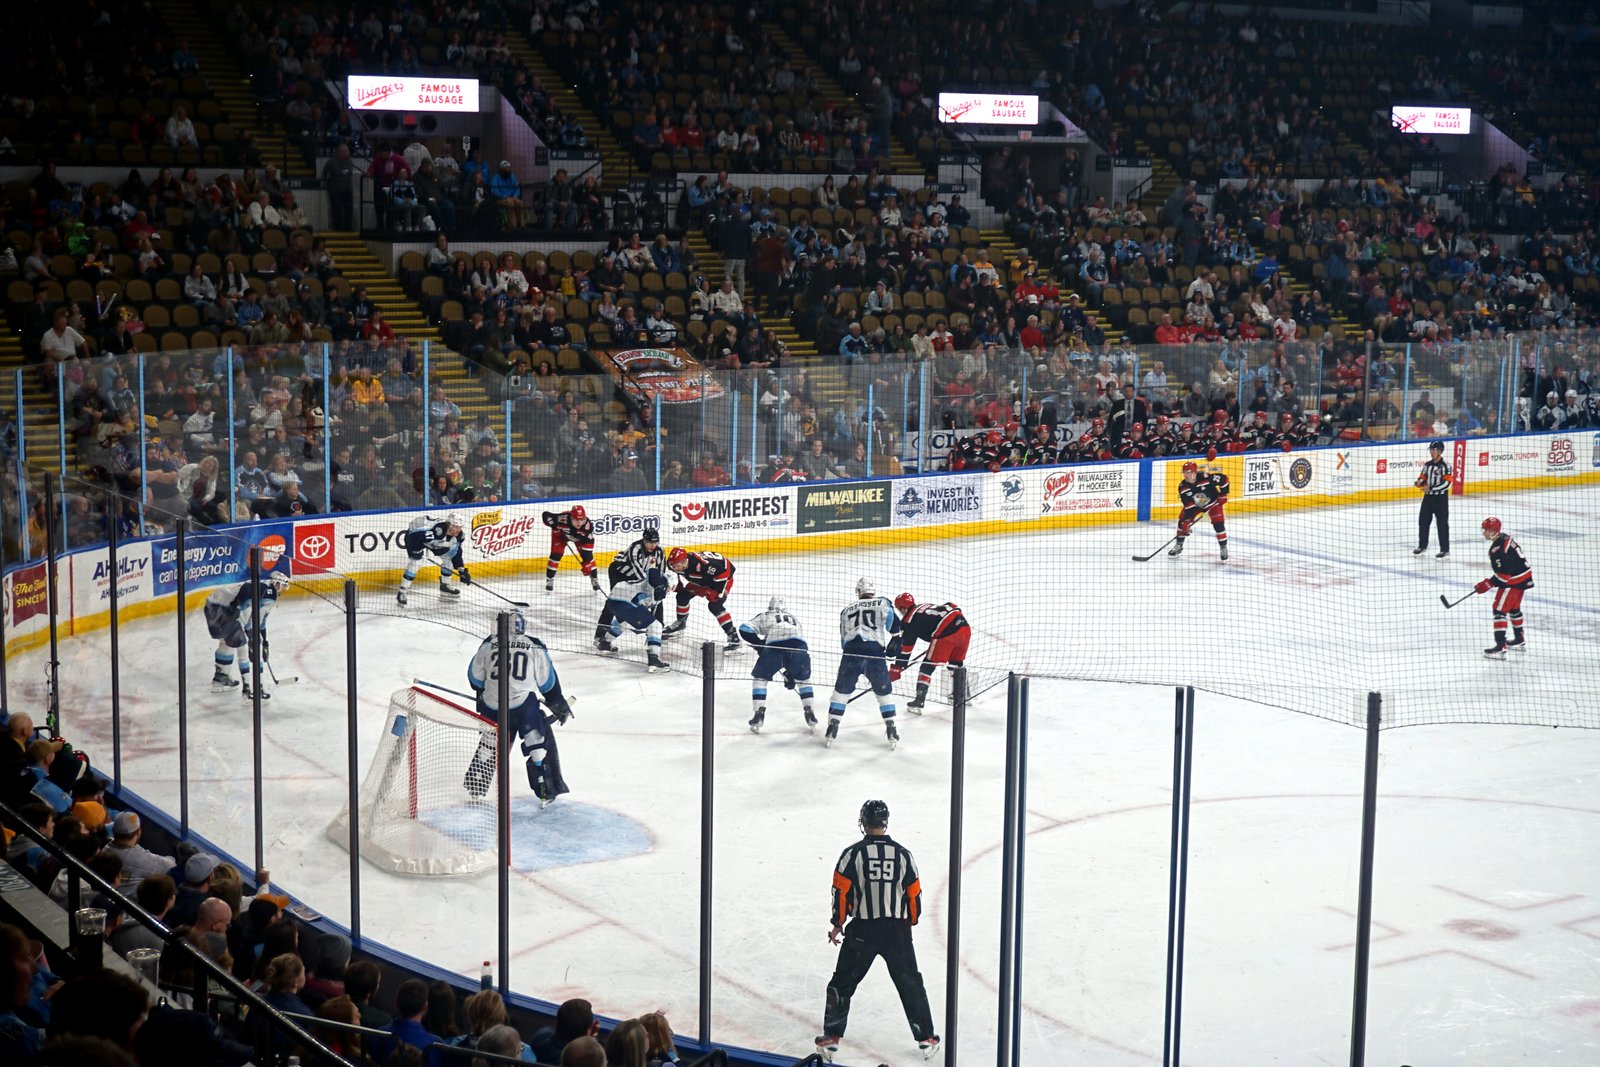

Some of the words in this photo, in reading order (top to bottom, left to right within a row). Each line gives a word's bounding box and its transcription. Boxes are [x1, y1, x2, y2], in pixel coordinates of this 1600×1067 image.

[421, 83, 460, 93] FAMOUS
[418, 94, 463, 104] SAUSAGE
[994, 100, 1025, 108] FAMOUS
[992, 110, 1026, 118] SAUSAGE
[1551, 439, 1572, 452] BIG
[1514, 452, 1539, 460] TUNDRA
[1547, 450, 1575, 465] 920
[1249, 462, 1270, 471] THIS
[1078, 472, 1123, 483] MILWAUKEE'S
[1249, 472, 1257, 482] IS
[1260, 471, 1274, 481] MY
[927, 487, 962, 499] INVEST
[965, 486, 975, 496] IN
[1086, 481, 1109, 491] HOCKEY
[1110, 480, 1122, 488] BAR
[1248, 481, 1275, 492] CREW
[805, 488, 884, 507] MILWAUKEE
[927, 496, 979, 514] MEMORIES
[672, 495, 789, 522] SUMMERFEST
[473, 515, 535, 546] Prairie
[593, 515, 660, 534] siFoam
[672, 526, 687, 534] June
[687, 524, 705, 533] 20-22
[709, 523, 723, 532] June
[723, 522, 741, 531] 27-29
[744, 520, 756, 529] July
[757, 519, 767, 527] 4-6
[344, 529, 409, 554] TOYO
[483, 533, 525, 555] Farms
[208, 546, 233, 561] you
[159, 569, 174, 584] can
[224, 562, 239, 574] on
[16, 595, 40, 608] SINCE
[847, 609, 878, 631] 70
[490, 651, 529, 682] 30
[868, 859, 895, 881] 59
